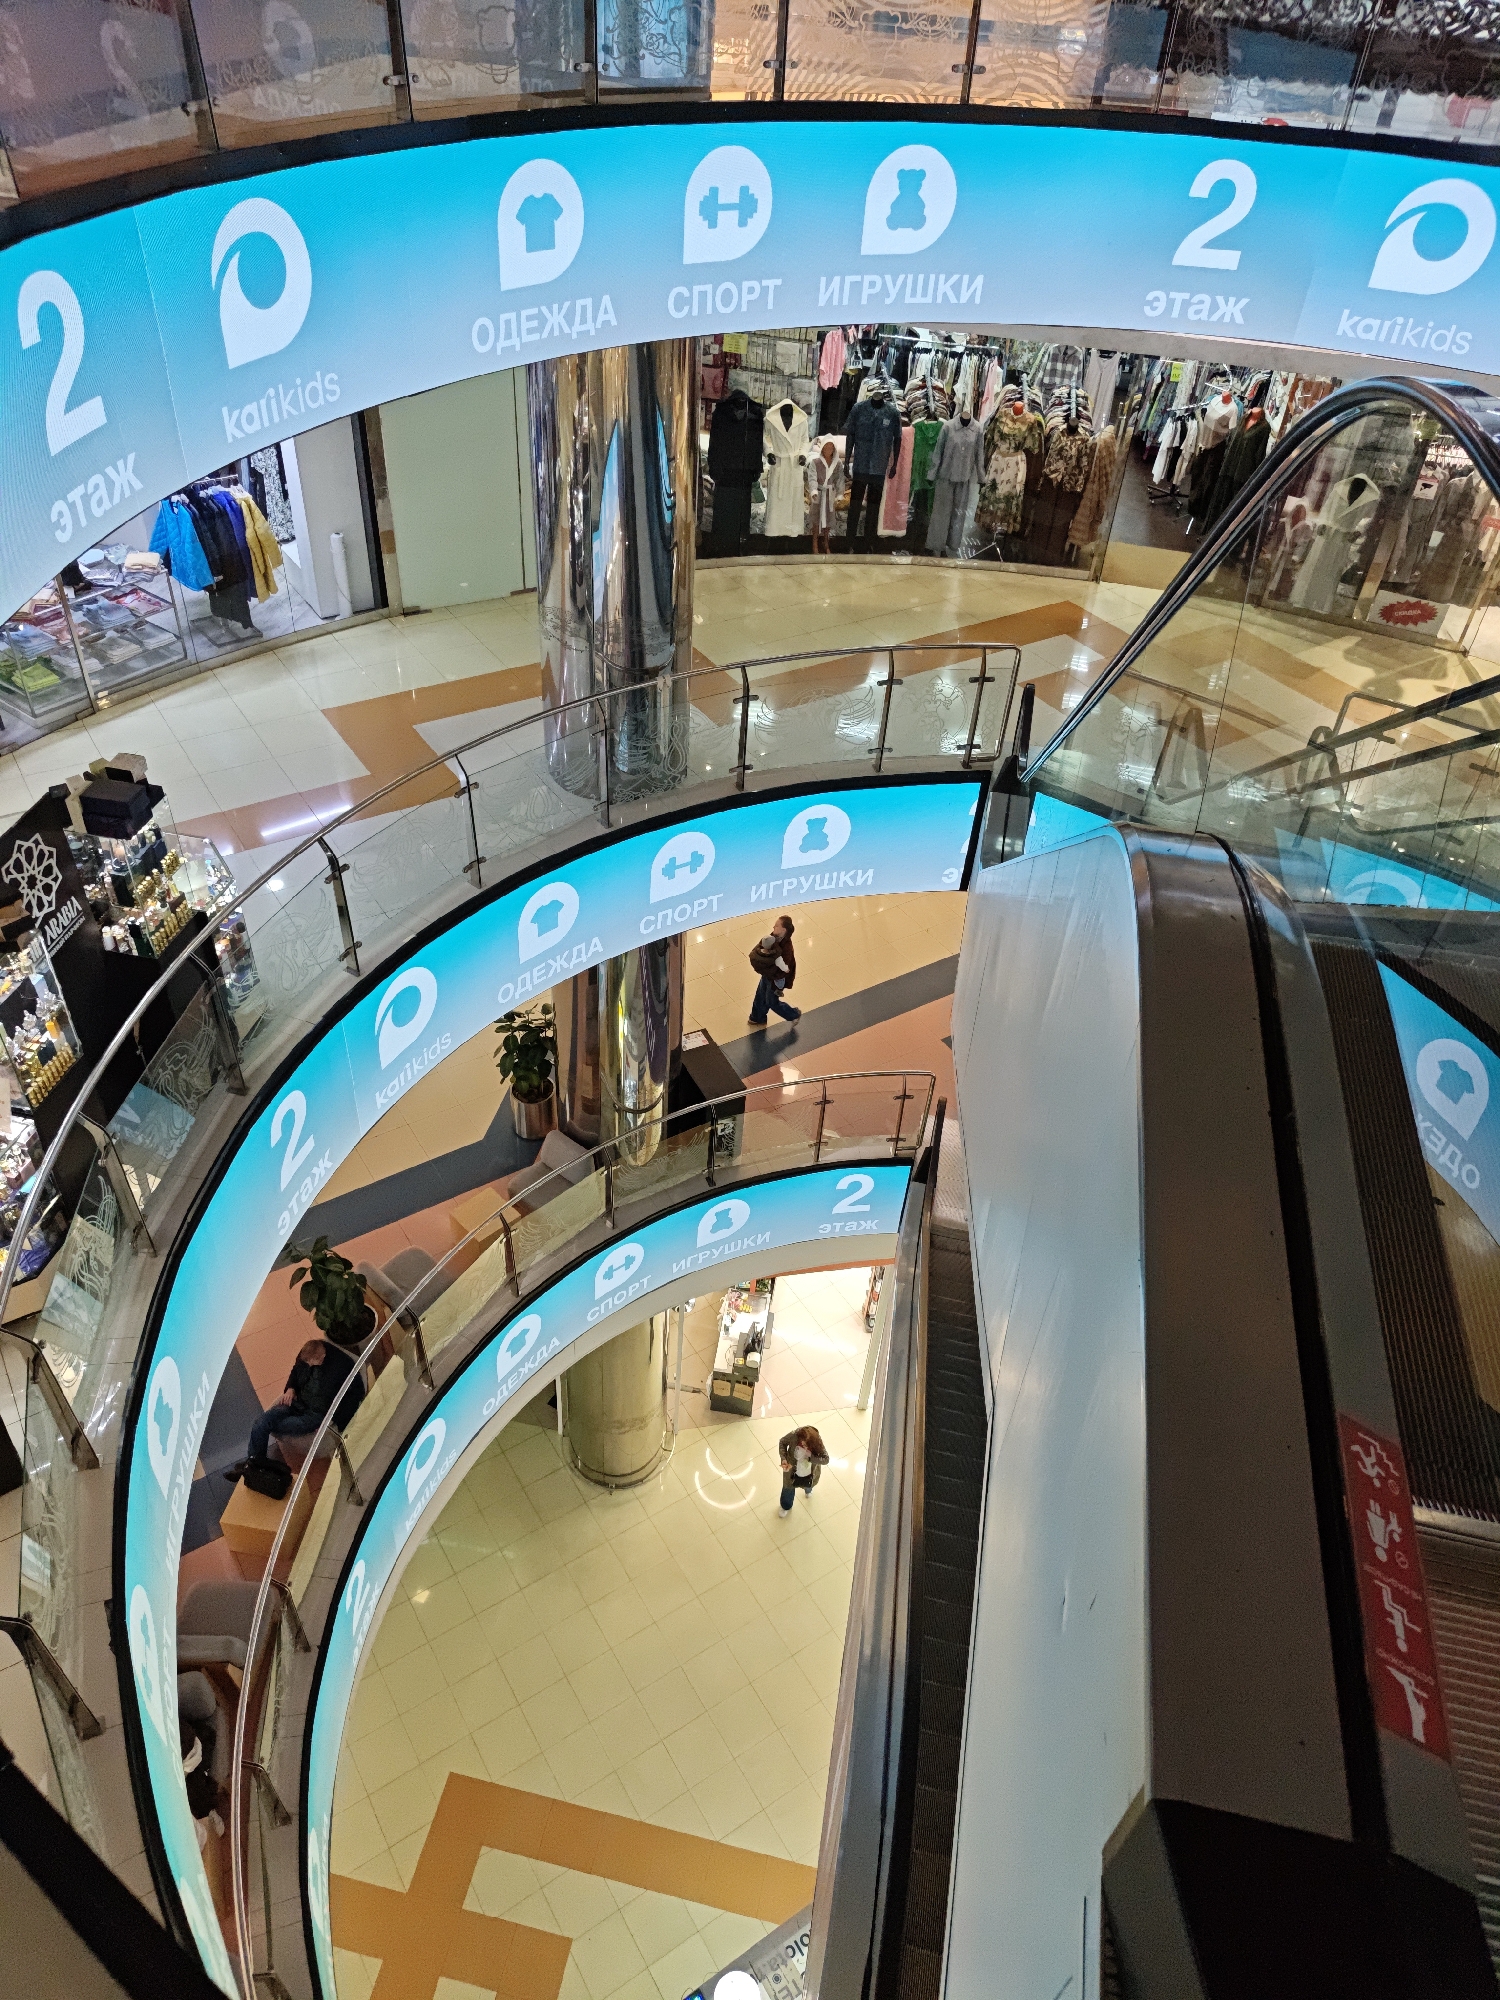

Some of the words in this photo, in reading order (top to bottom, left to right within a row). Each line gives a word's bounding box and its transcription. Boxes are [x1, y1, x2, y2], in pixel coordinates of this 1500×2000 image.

[1172, 159, 1256, 270] 2
[668, 278, 782, 320] СПОРТ
[817, 274, 985, 307] ИГРУШКИ
[1143, 290, 1250, 325] этаж
[471, 294, 617, 355] ОДЕЖДА
[1336, 309, 1472, 355] karikids
[18, 269, 107, 456] 2
[221, 370, 341, 443] karikids
[50, 451, 143, 544] этаж
[639, 894, 724, 935] СПОРТ
[750, 869, 875, 904] ИГРУШКИ
[44, 895, 83, 946] ARABIA
[497, 936, 603, 1005] ОДЕЖДА
[375, 1032, 452, 1110] karikids
[270, 1090, 315, 1192] 2
[278, 1148, 333, 1236] этаж
[831, 1173, 875, 1215] 2
[672, 1230, 771, 1274] ИГРУШКИ
[818, 1219, 879, 1234] этаж
[586, 1275, 652, 1322] СПОРТ
[482, 1336, 560, 1416] ОДЕЖДА
[166, 1370, 211, 1577] ИГРУШКИ
[405, 1448, 457, 1532] karikids
[345, 1559, 371, 1638] 2
